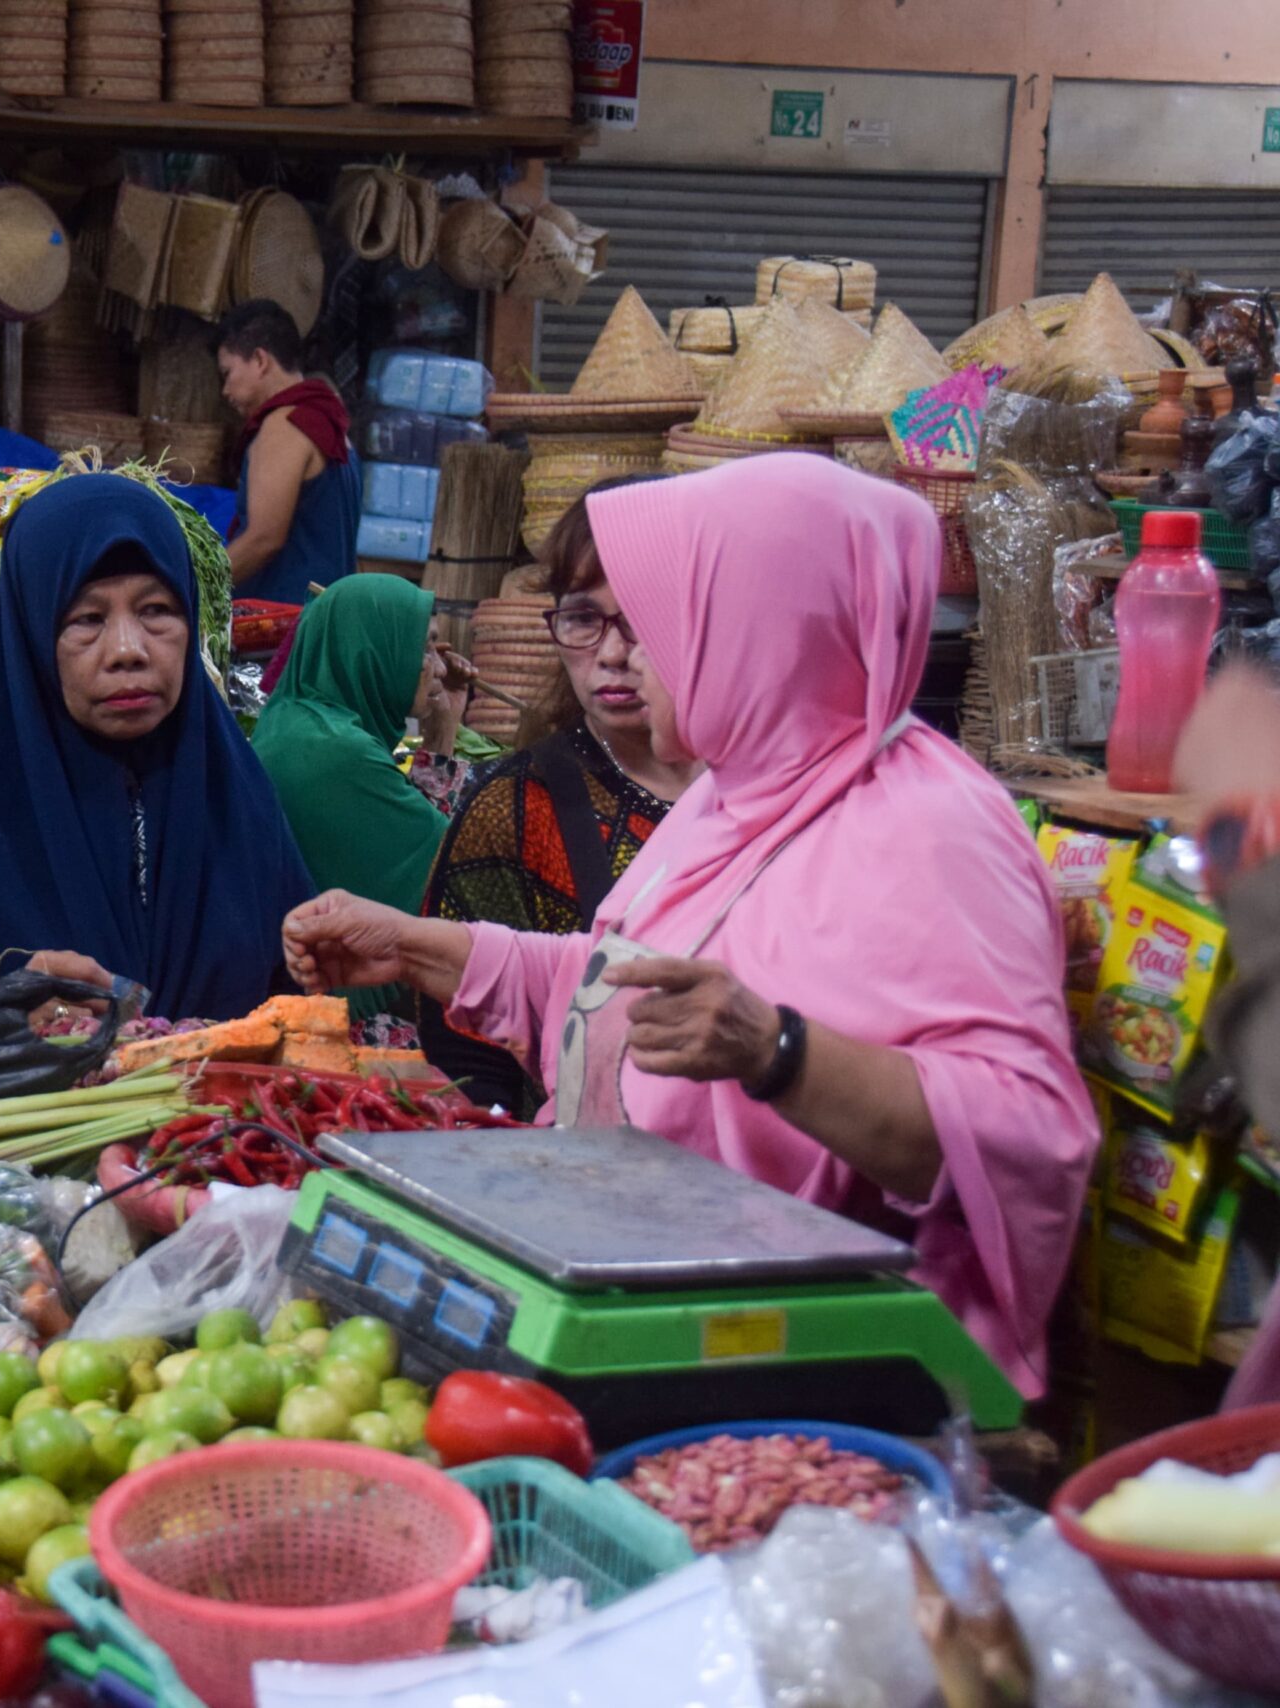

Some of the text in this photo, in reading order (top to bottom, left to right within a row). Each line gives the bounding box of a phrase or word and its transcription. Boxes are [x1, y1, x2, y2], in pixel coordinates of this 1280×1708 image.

[792, 109, 820, 136] 24
[1049, 838, 1111, 872] Racik
[1126, 937, 1190, 983] Racik
